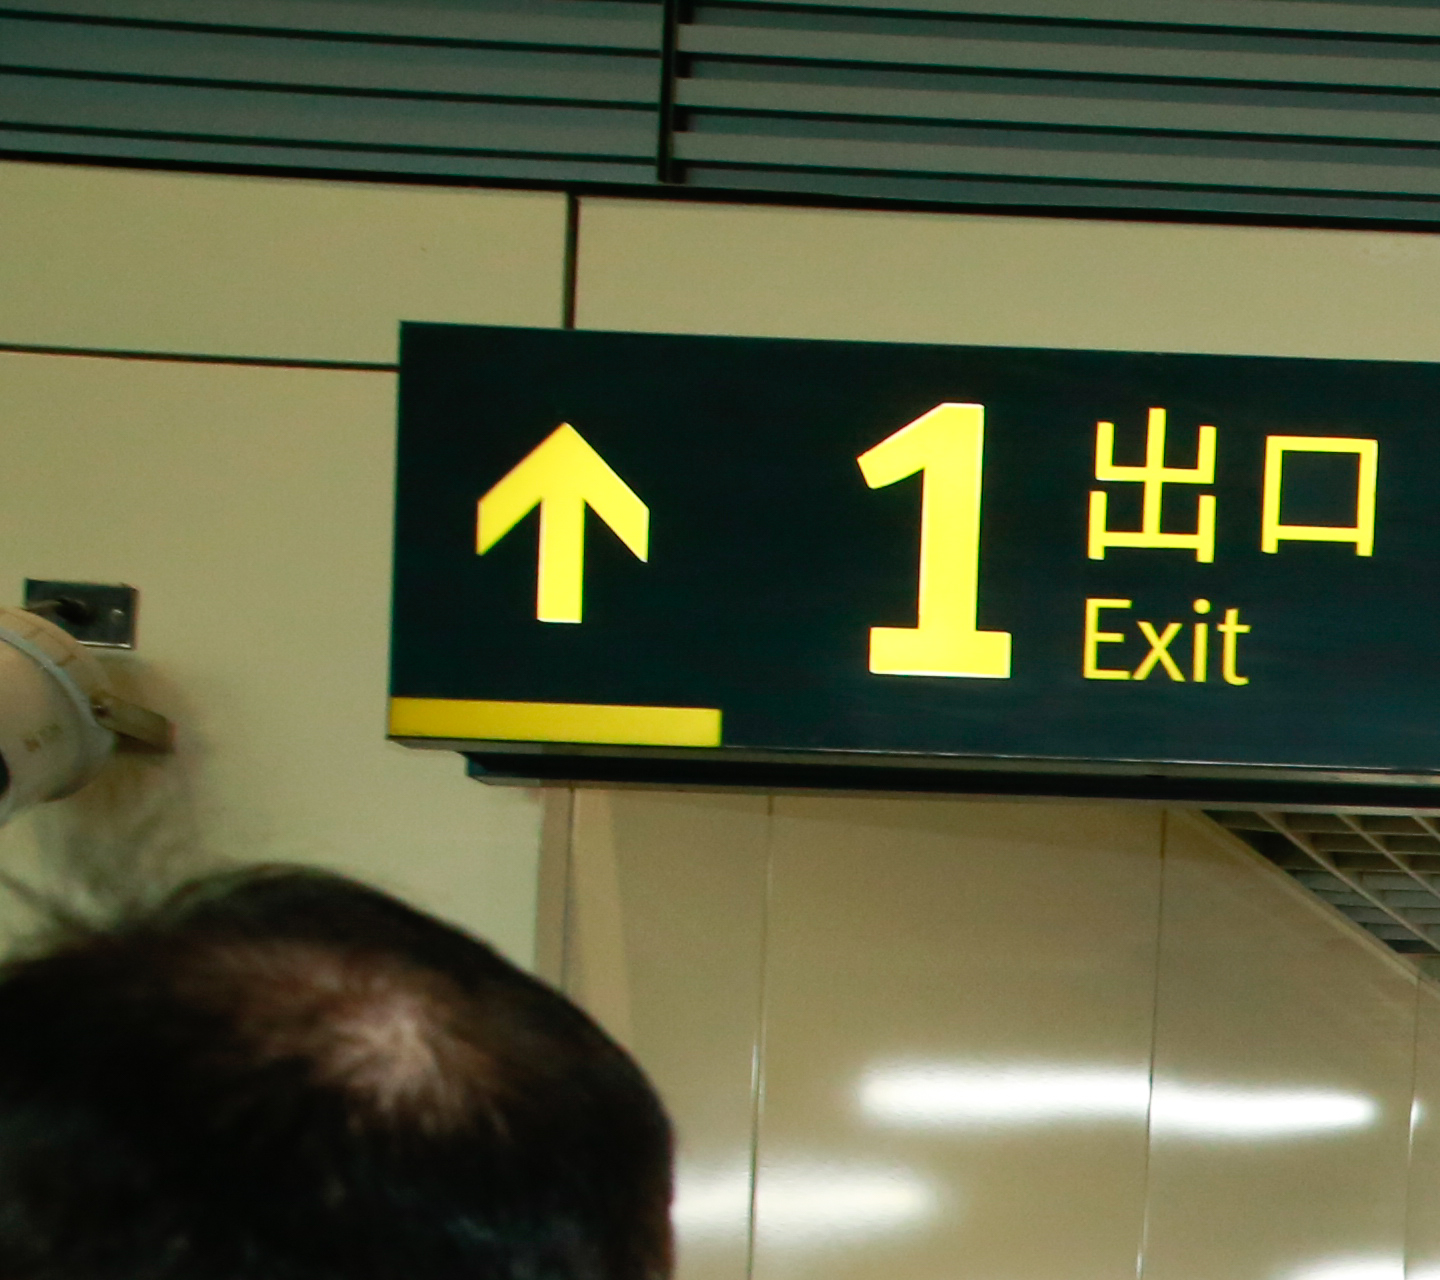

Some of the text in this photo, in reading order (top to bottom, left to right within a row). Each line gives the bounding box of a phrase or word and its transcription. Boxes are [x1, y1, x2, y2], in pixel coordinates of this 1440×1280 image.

[857, 402, 1012, 679] 1
[1087, 407, 1379, 564] 出口
[1083, 598, 1251, 686] Exit
